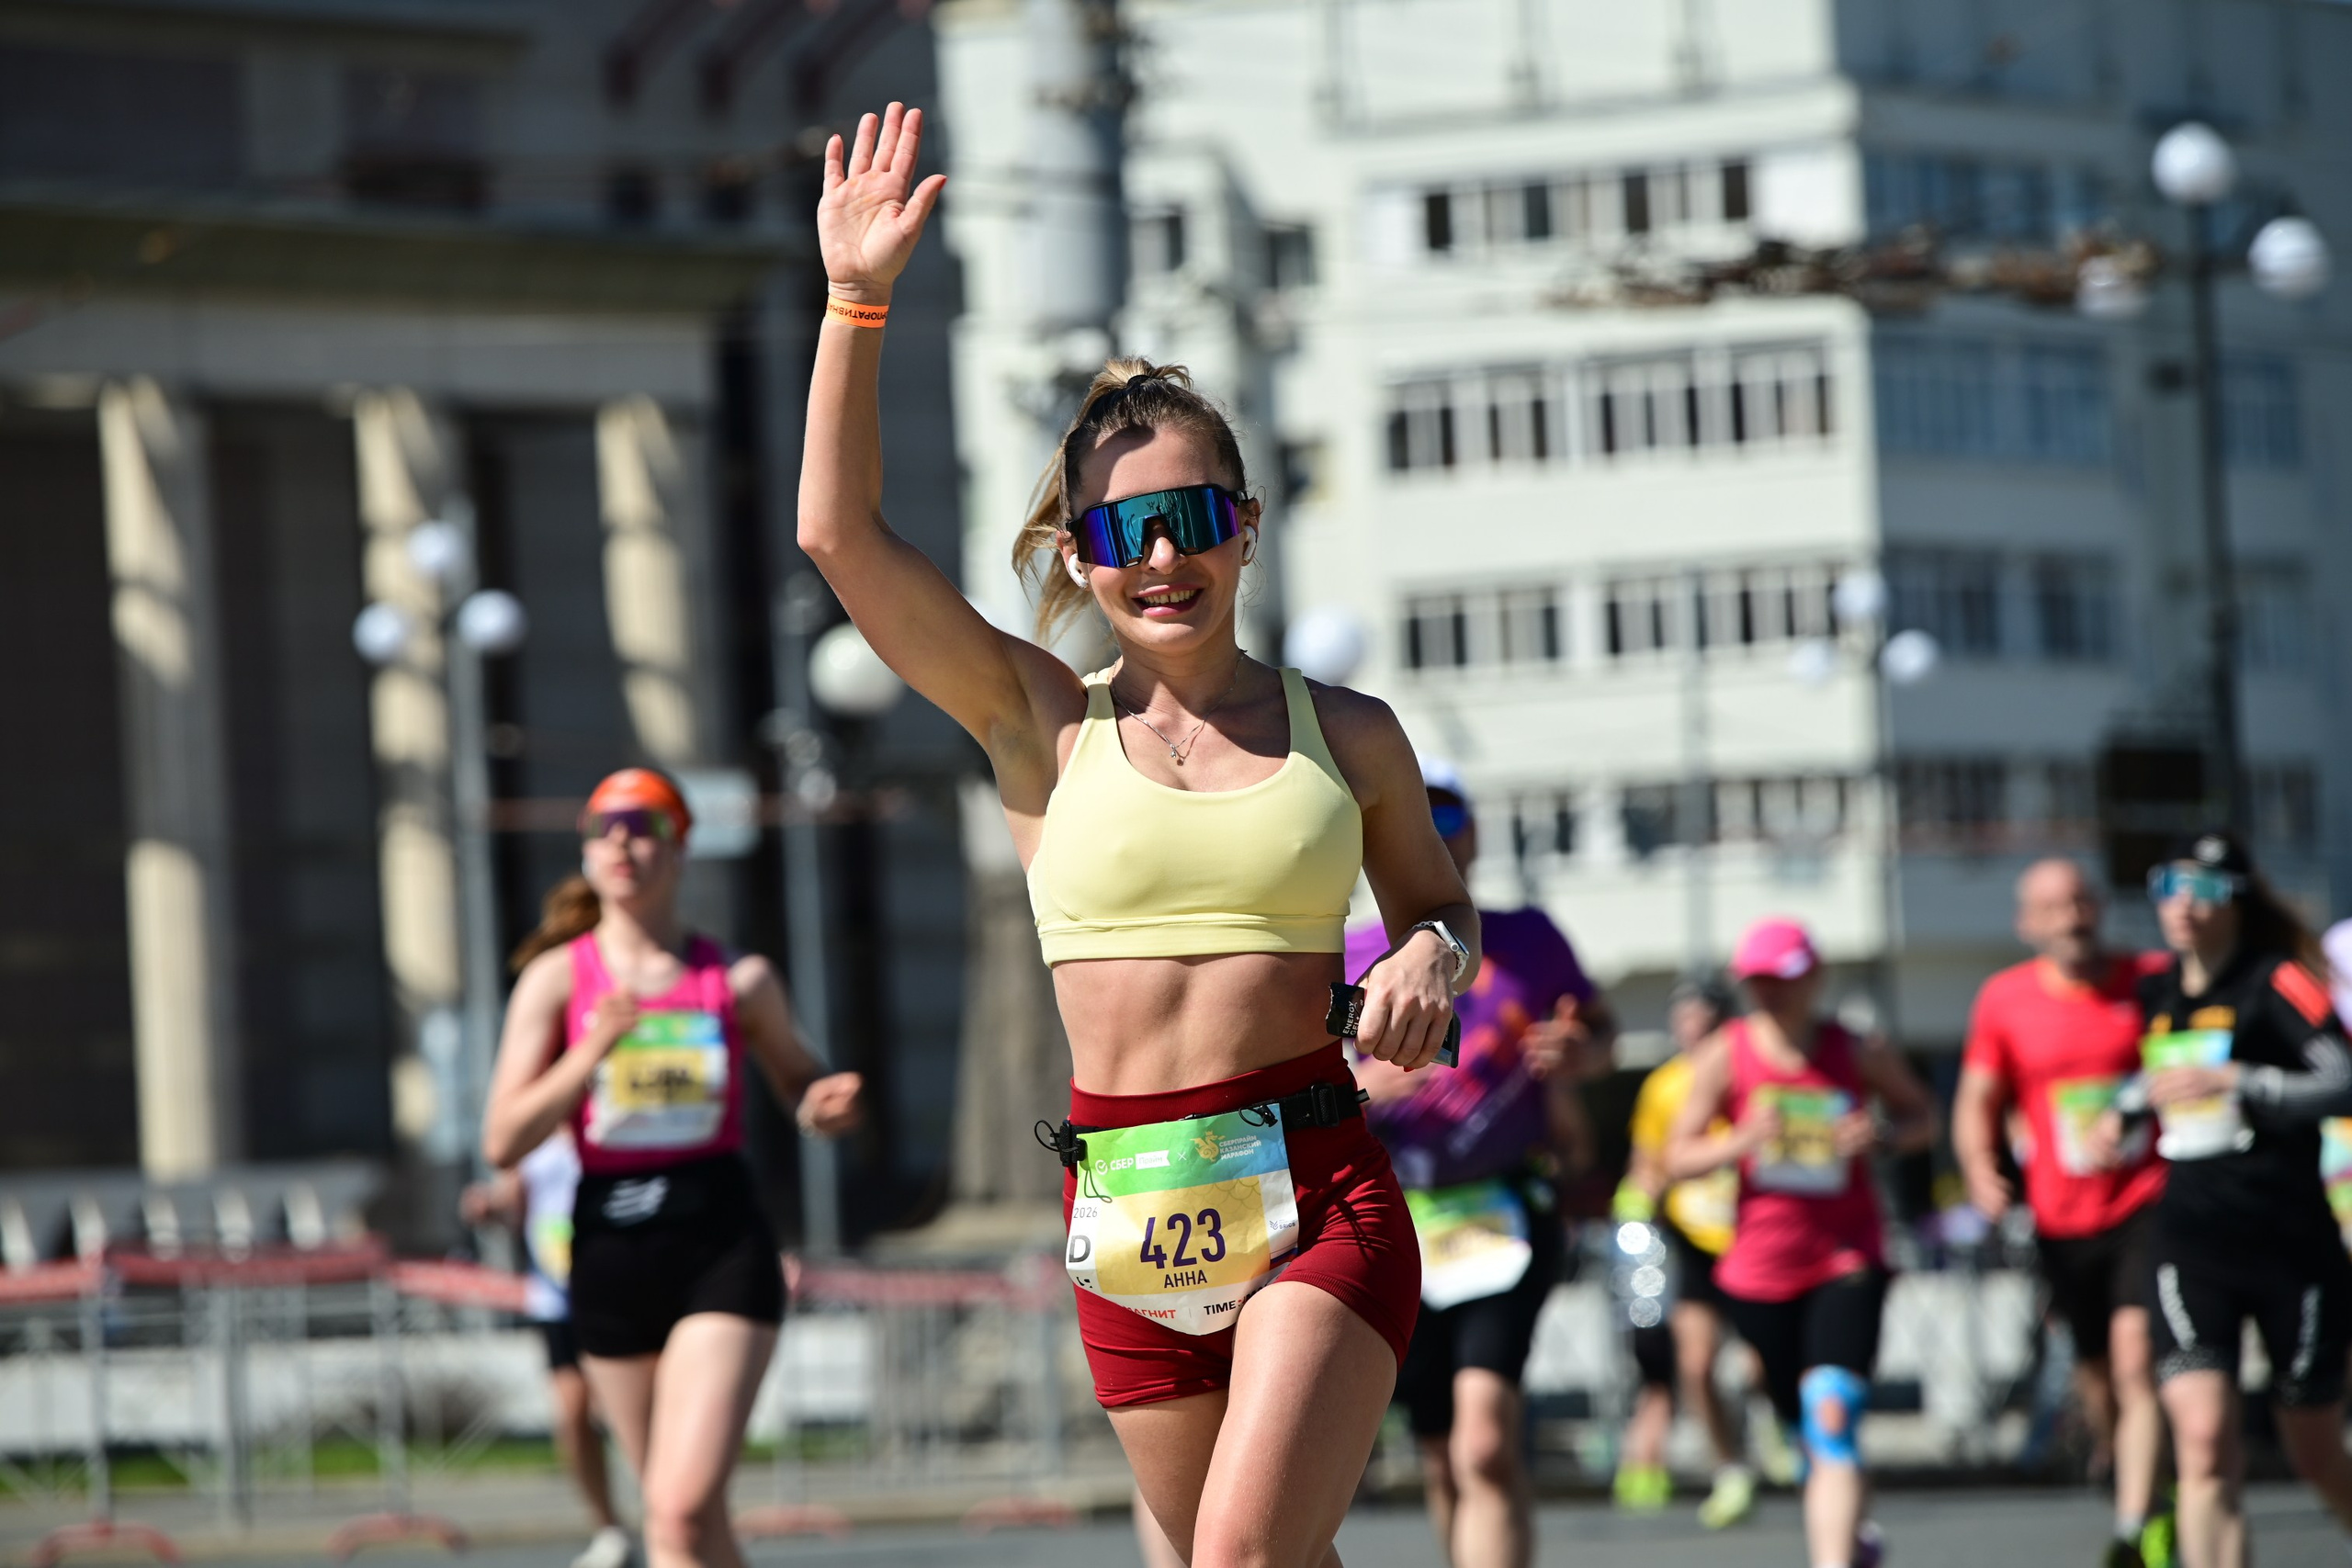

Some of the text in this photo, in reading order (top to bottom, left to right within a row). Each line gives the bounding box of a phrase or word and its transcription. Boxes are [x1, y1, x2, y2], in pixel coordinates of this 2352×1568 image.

[1342, 1000, 1354, 1034] ENERGY
[1219, 1135, 1257, 1147] СБЕРПРАЙМ
[1220, 1140, 1261, 1154] КАЗАНСКИЙ
[1221, 1149, 1254, 1160] МАРАФОН
[1110, 1155, 1163, 1170] СБЕР Прайм
[1073, 1206, 1098, 1219] 2026
[1140, 1208, 1226, 1269] 423
[1069, 1235, 1091, 1263] D
[1164, 1269, 1207, 1289] АННА
[1123, 1305, 1176, 1319] АГНИТ
